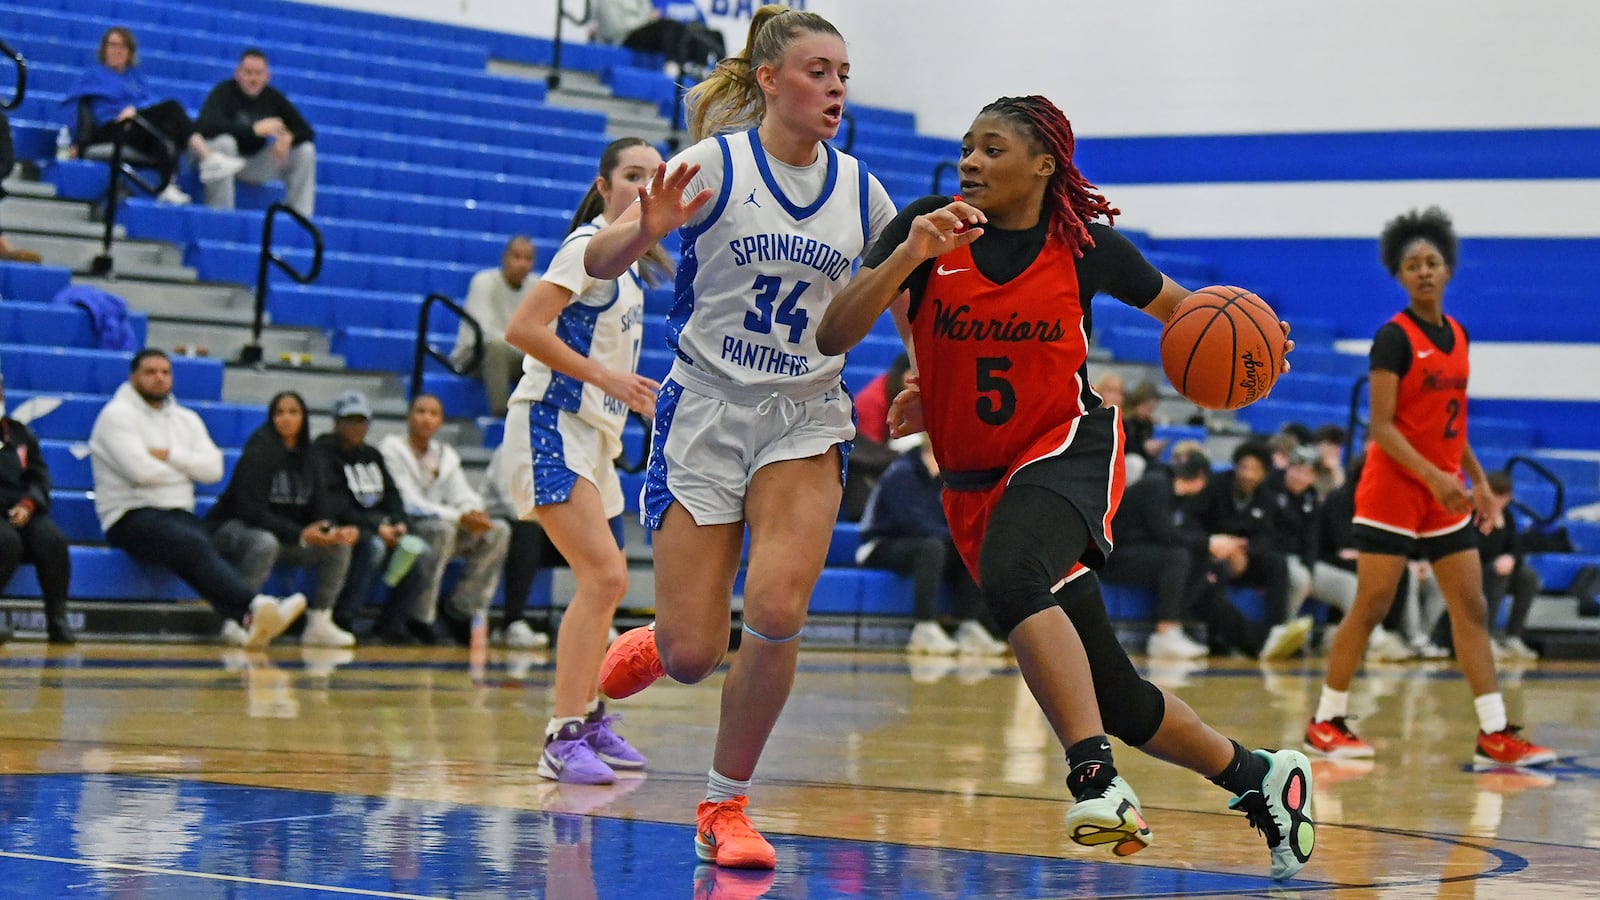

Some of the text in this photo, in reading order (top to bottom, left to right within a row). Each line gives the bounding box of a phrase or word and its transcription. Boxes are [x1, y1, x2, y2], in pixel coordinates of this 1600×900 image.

[729, 233, 850, 282] SPRINGBORO
[743, 274, 811, 344] 34
[932, 299, 1065, 342] Warriors
[721, 335, 809, 377] PANTHERS
[975, 355, 1018, 426] 5
[1443, 398, 1459, 439] 2
